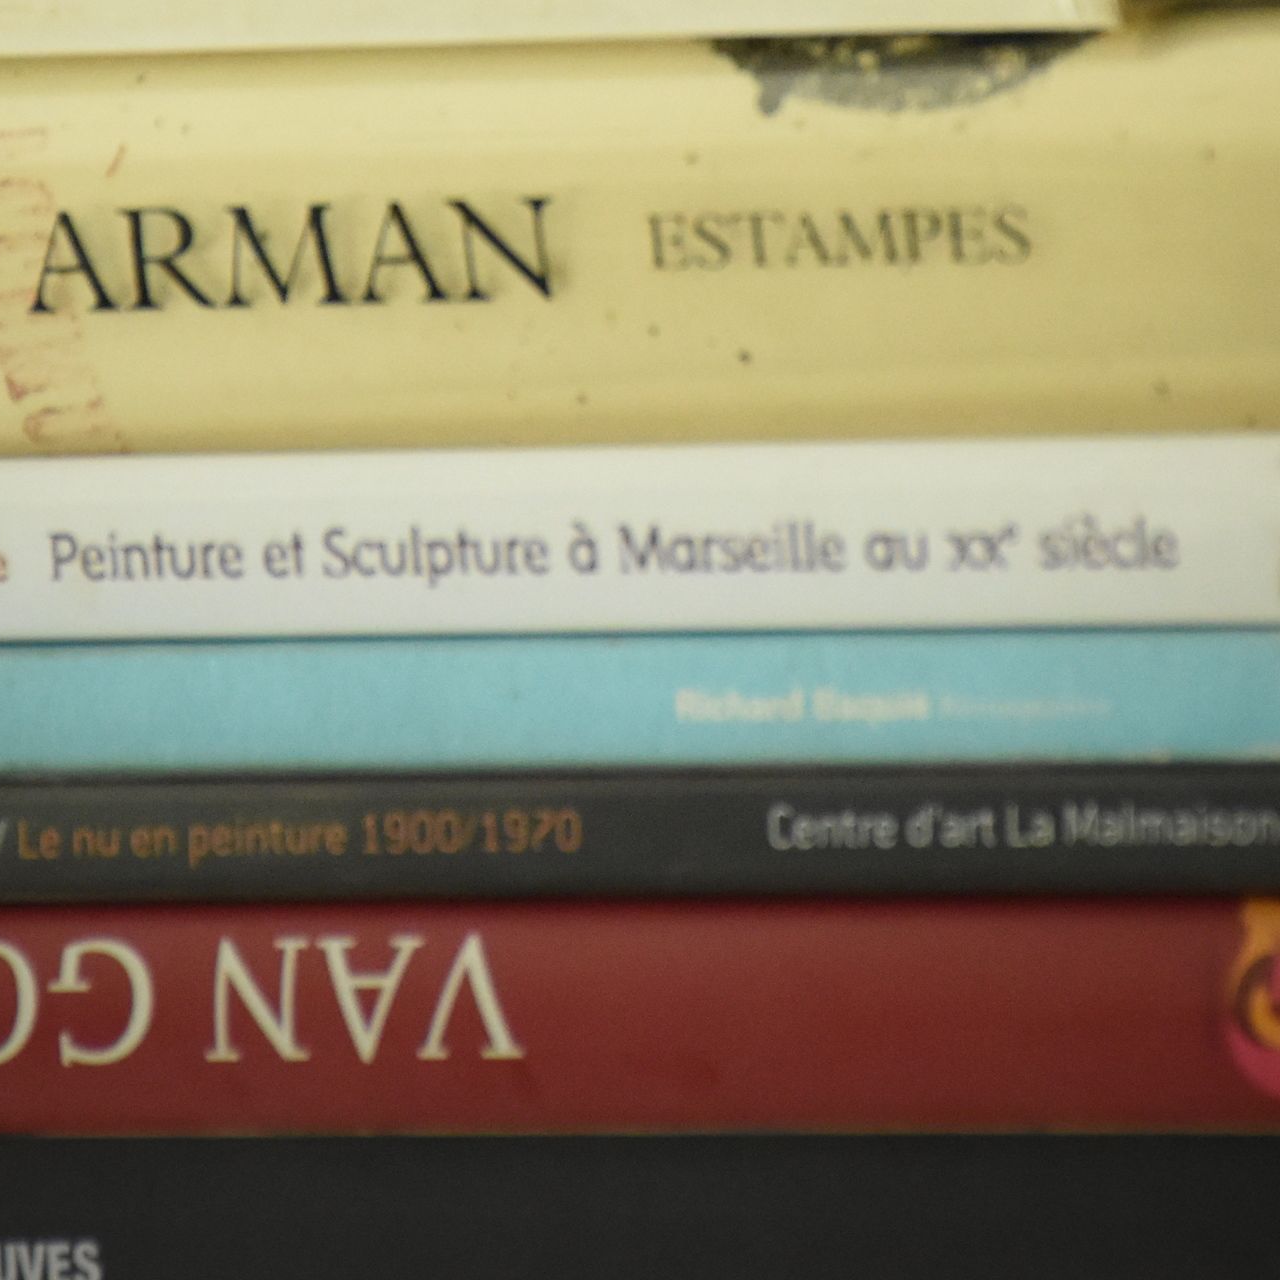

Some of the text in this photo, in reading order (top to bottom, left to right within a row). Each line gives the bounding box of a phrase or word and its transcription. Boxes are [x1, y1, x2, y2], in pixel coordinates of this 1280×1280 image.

[25, 191, 557, 315] ARMAN
[644, 203, 1035, 272] ESTAMPES
[48, 532, 245, 582] Peinture
[262, 532, 304, 578] et
[320, 526, 550, 589] Sculpture
[569, 515, 601, 576] à
[618, 521, 847, 574] Marseille
[863, 529, 930, 572] au
[1037, 513, 1183, 572] siècle
[19, 819, 59, 861] Le
[72, 824, 120, 860] nu
[130, 824, 177, 861] en
[188, 819, 348, 869] peinture
[766, 801, 900, 851] Centre
[906, 801, 1000, 850] d'art
[1005, 800, 1056, 849] La
[204, 931, 526, 1066] VAN
